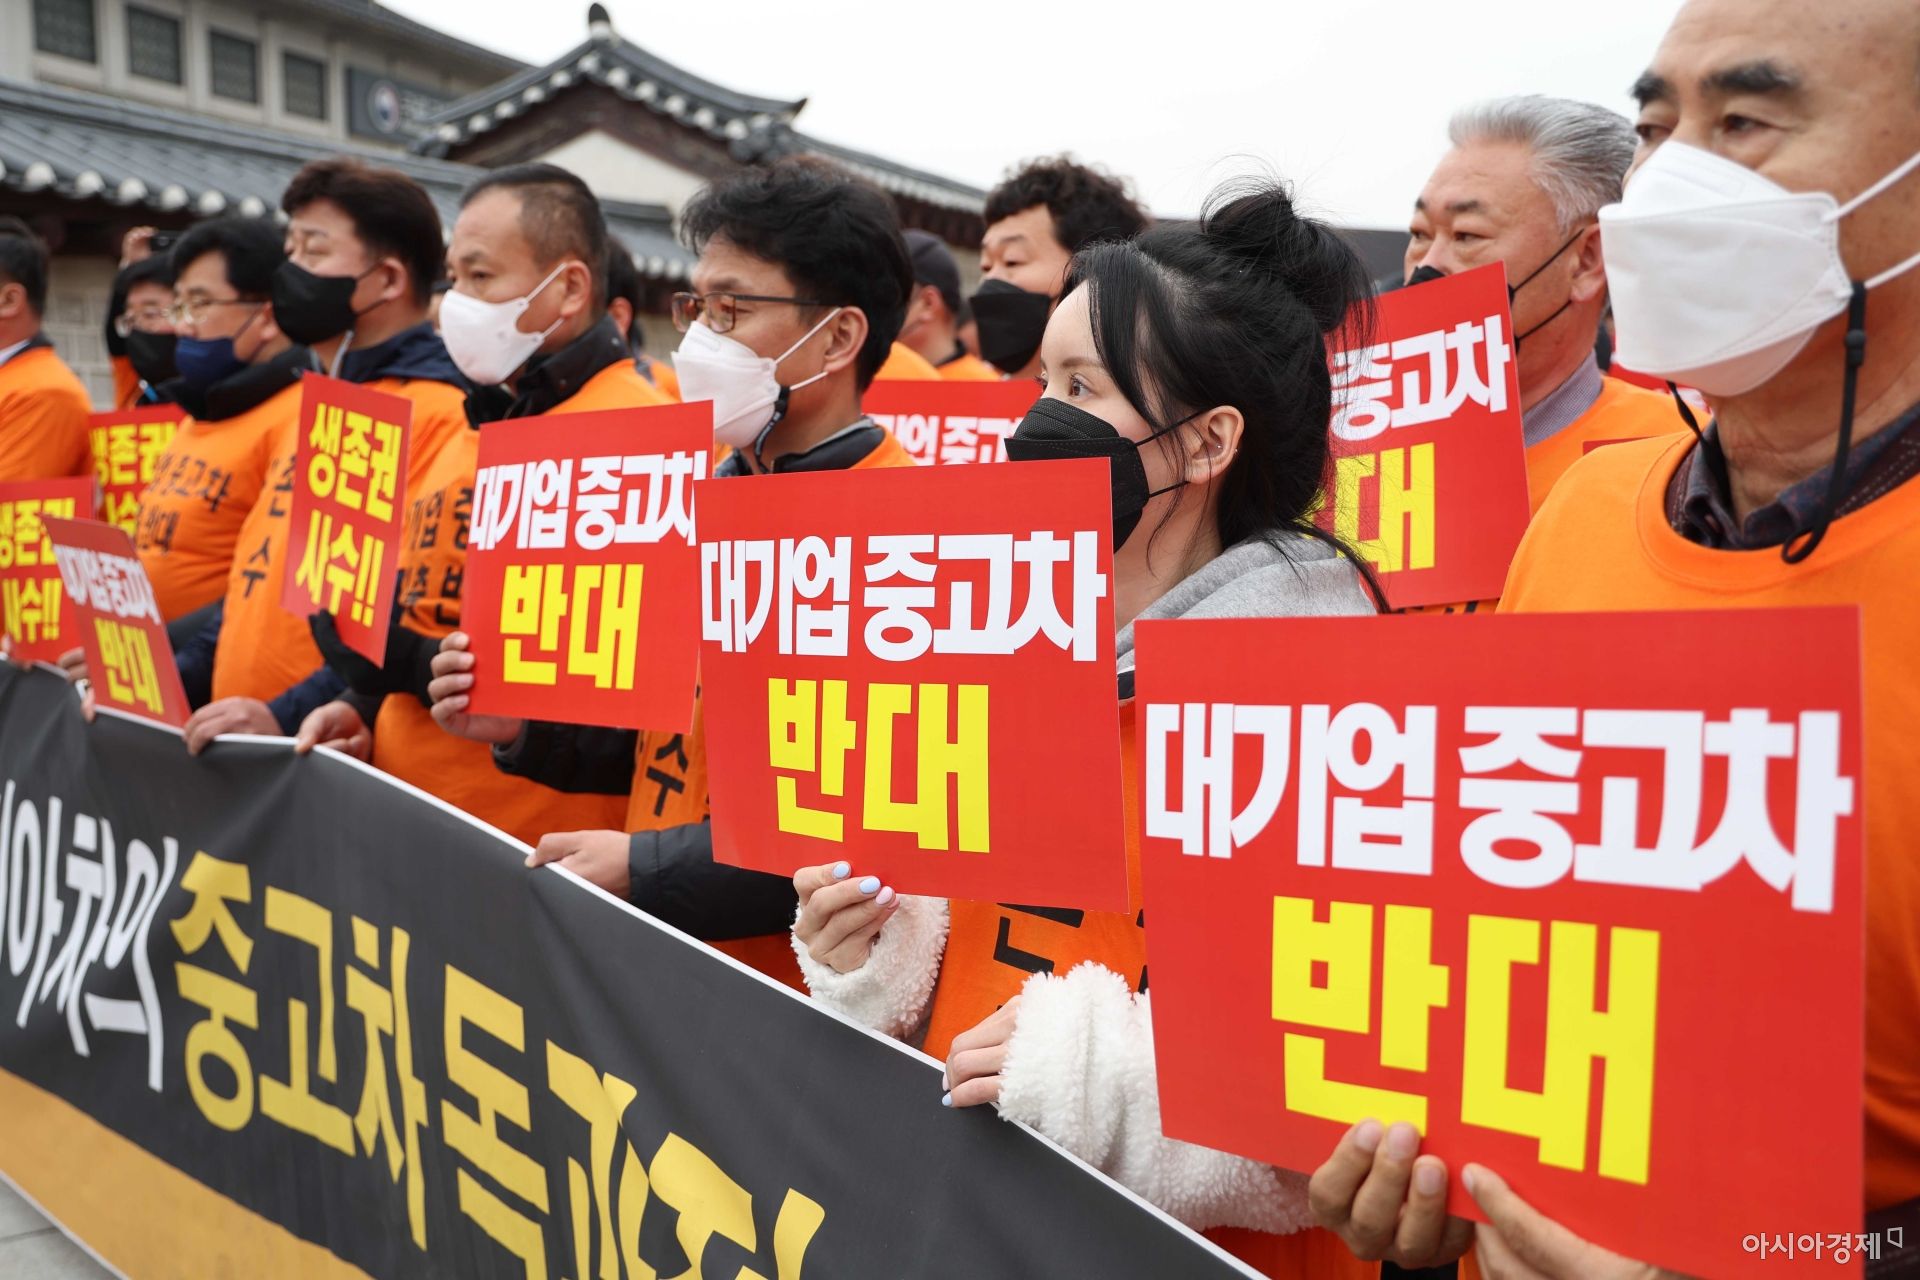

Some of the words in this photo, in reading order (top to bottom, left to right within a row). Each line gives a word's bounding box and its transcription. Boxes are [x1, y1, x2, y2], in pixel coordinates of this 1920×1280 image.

[308, 403, 402, 523] 생존권
[469, 459, 573, 551] 대기업
[575, 450, 707, 551] 중고차
[941, 415, 1024, 466] 중고
[295, 509, 384, 628] 사수!!
[1303, 442, 1436, 574] 대
[500, 563, 644, 690] 반대
[701, 535, 852, 657] 대기업
[863, 530, 1107, 662] 중고차
[94, 617, 164, 715] 반대
[768, 677, 991, 854] 반대
[1145, 701, 1438, 876] 대기업
[1458, 708, 1854, 913] 중고차
[0, 779, 179, 1093] 아차의
[170, 850, 428, 1251] 중고차
[1271, 895, 1661, 1186] 반대
